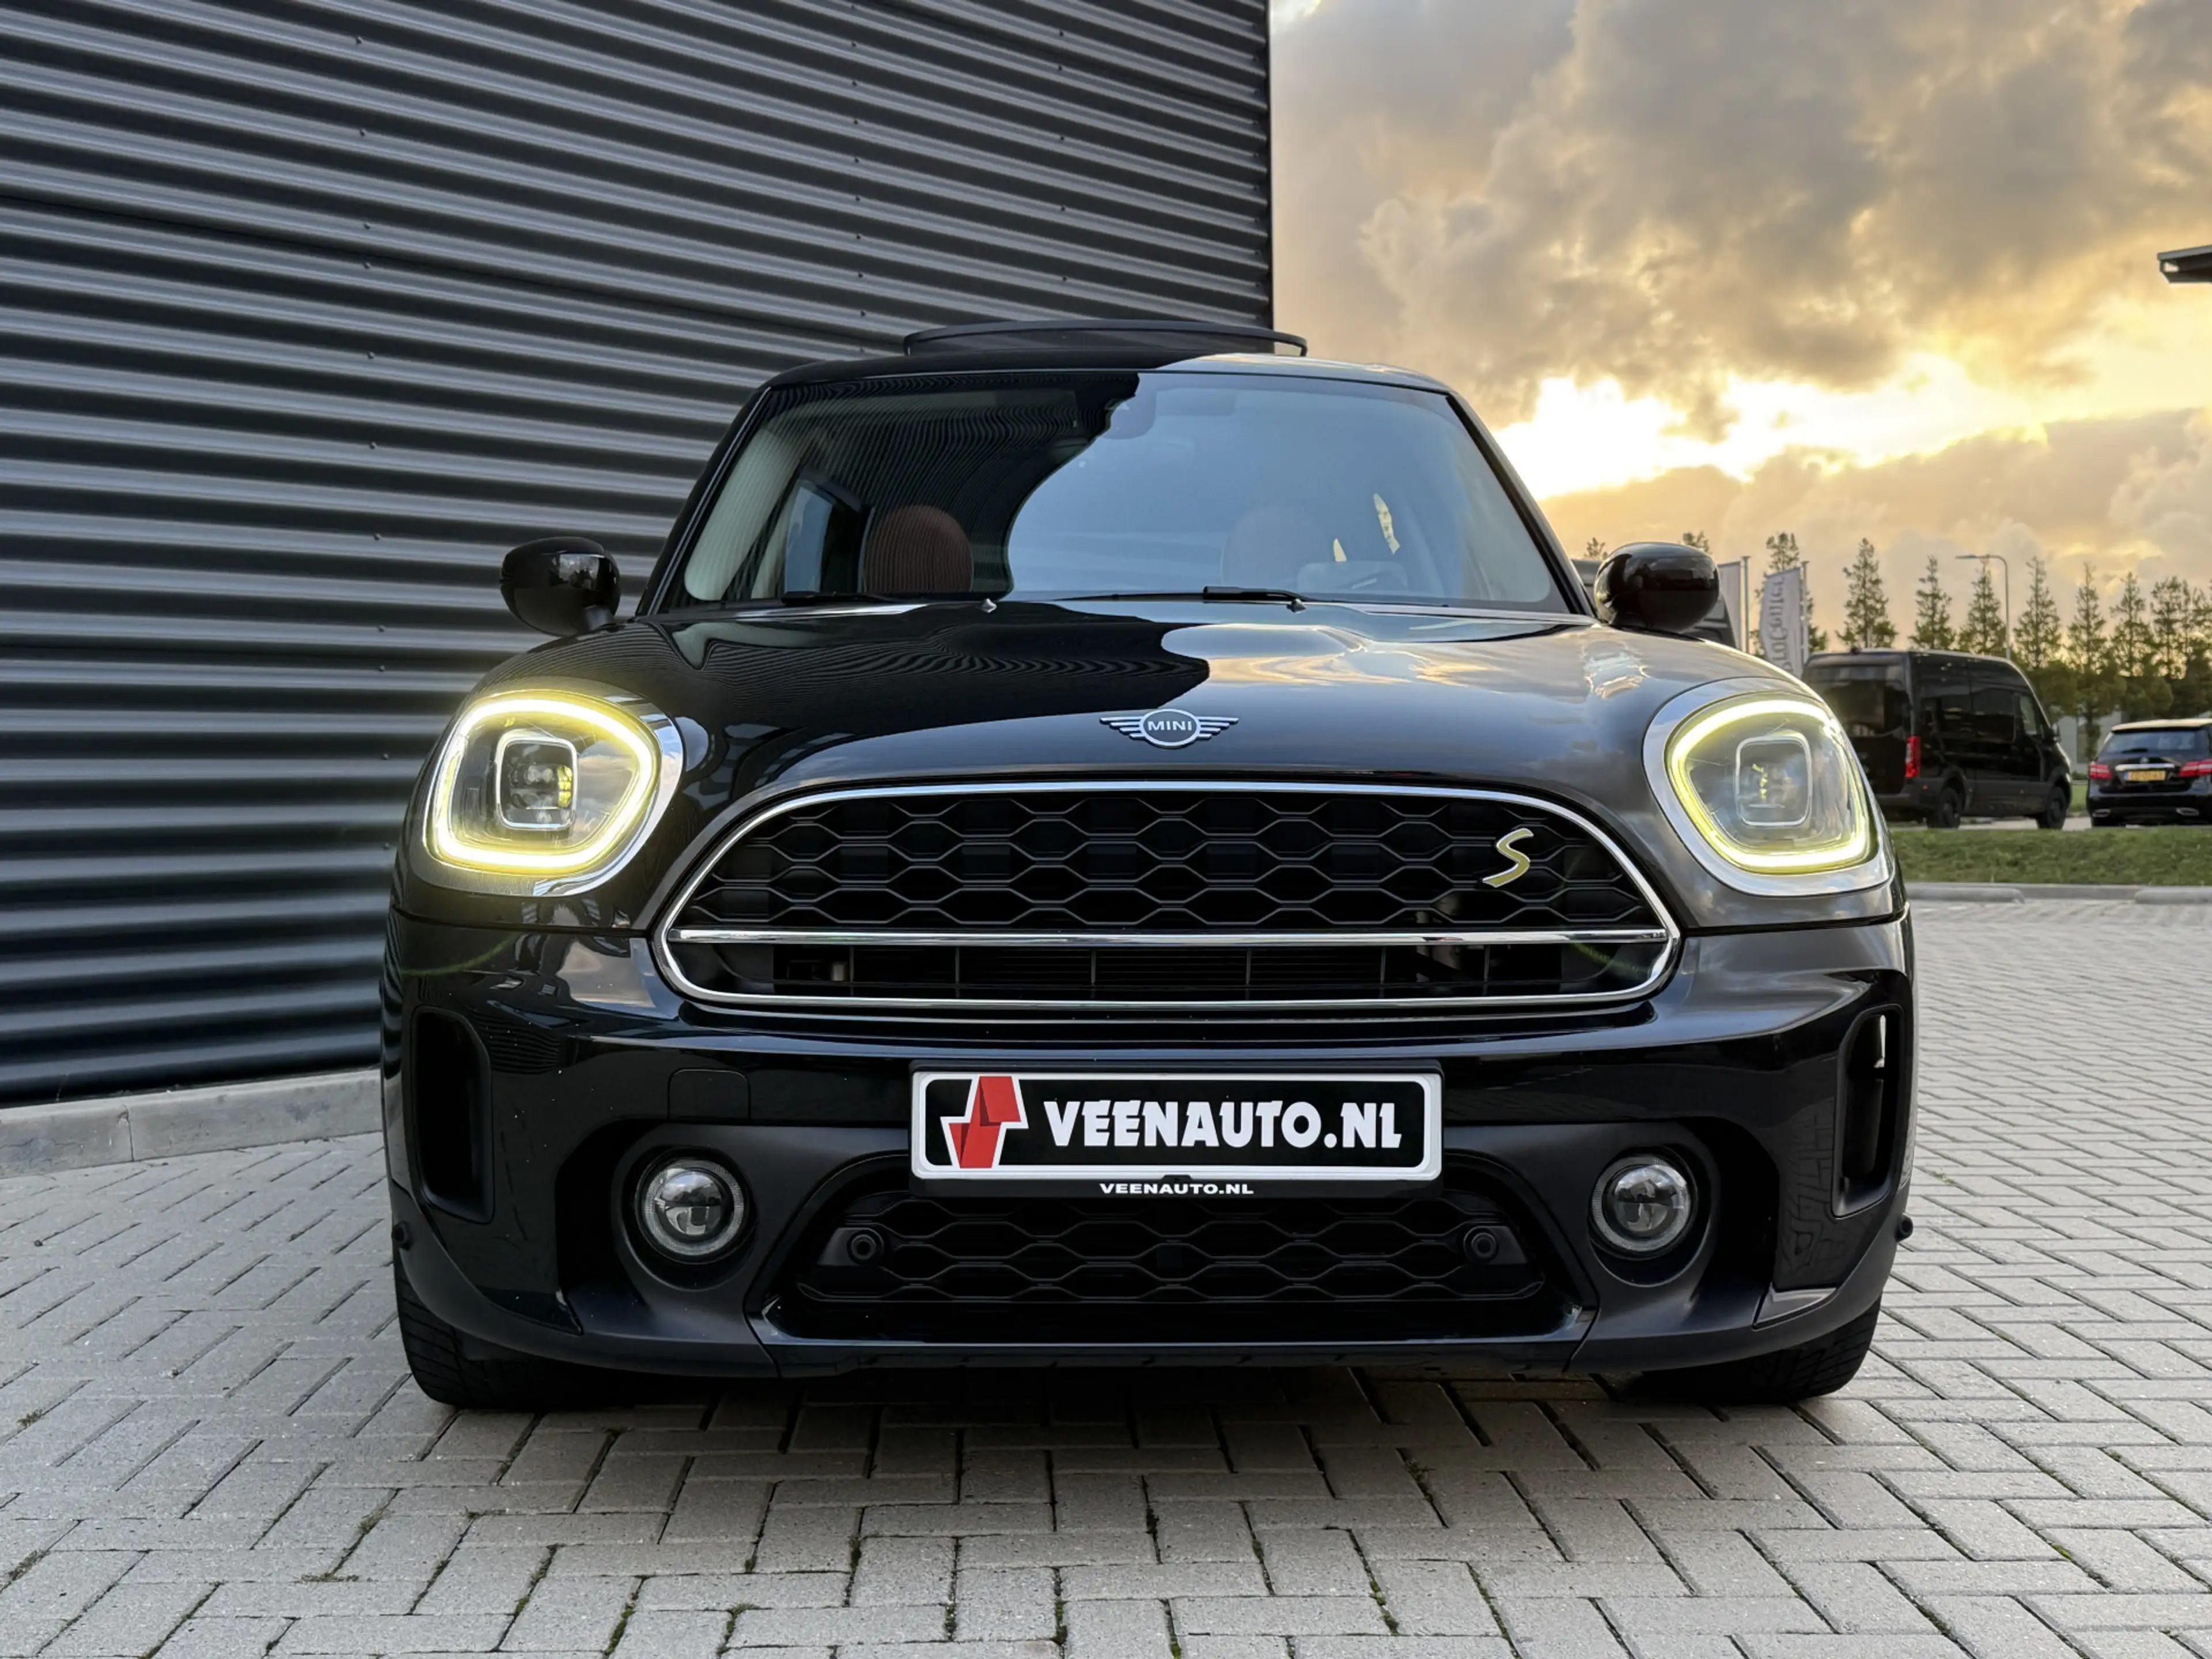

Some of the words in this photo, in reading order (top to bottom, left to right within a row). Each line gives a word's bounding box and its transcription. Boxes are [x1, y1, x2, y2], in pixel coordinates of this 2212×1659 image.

[1147, 721, 1192, 731] MINI
[1482, 828, 1534, 888] S
[1044, 1099, 1402, 1149] VEENAUTO.NL
[1099, 1183, 1254, 1195] VEENAUTO.NL
